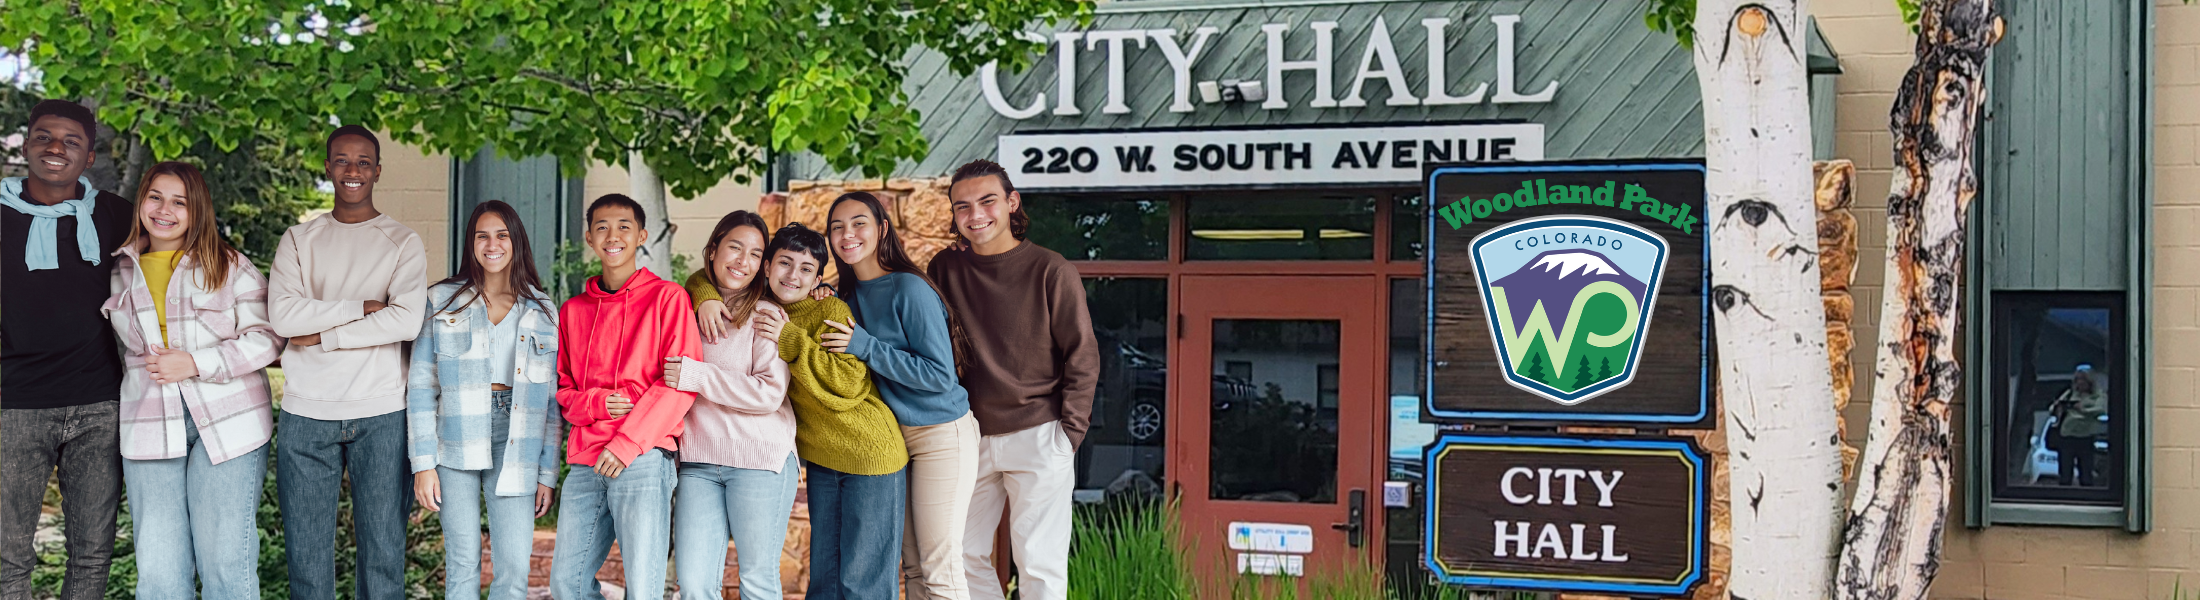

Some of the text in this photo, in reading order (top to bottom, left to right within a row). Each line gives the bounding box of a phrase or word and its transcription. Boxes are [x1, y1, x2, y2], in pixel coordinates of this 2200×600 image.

[980, 15, 1559, 120] CITY HALL
[1023, 137, 1516, 174] 220 W. SOUTH AVENUE
[1438, 178, 1698, 235] Woodland Park
[1515, 232, 1622, 250] COLORADO
[1500, 466, 1624, 507] CITY
[1493, 520, 1629, 562] HALL
